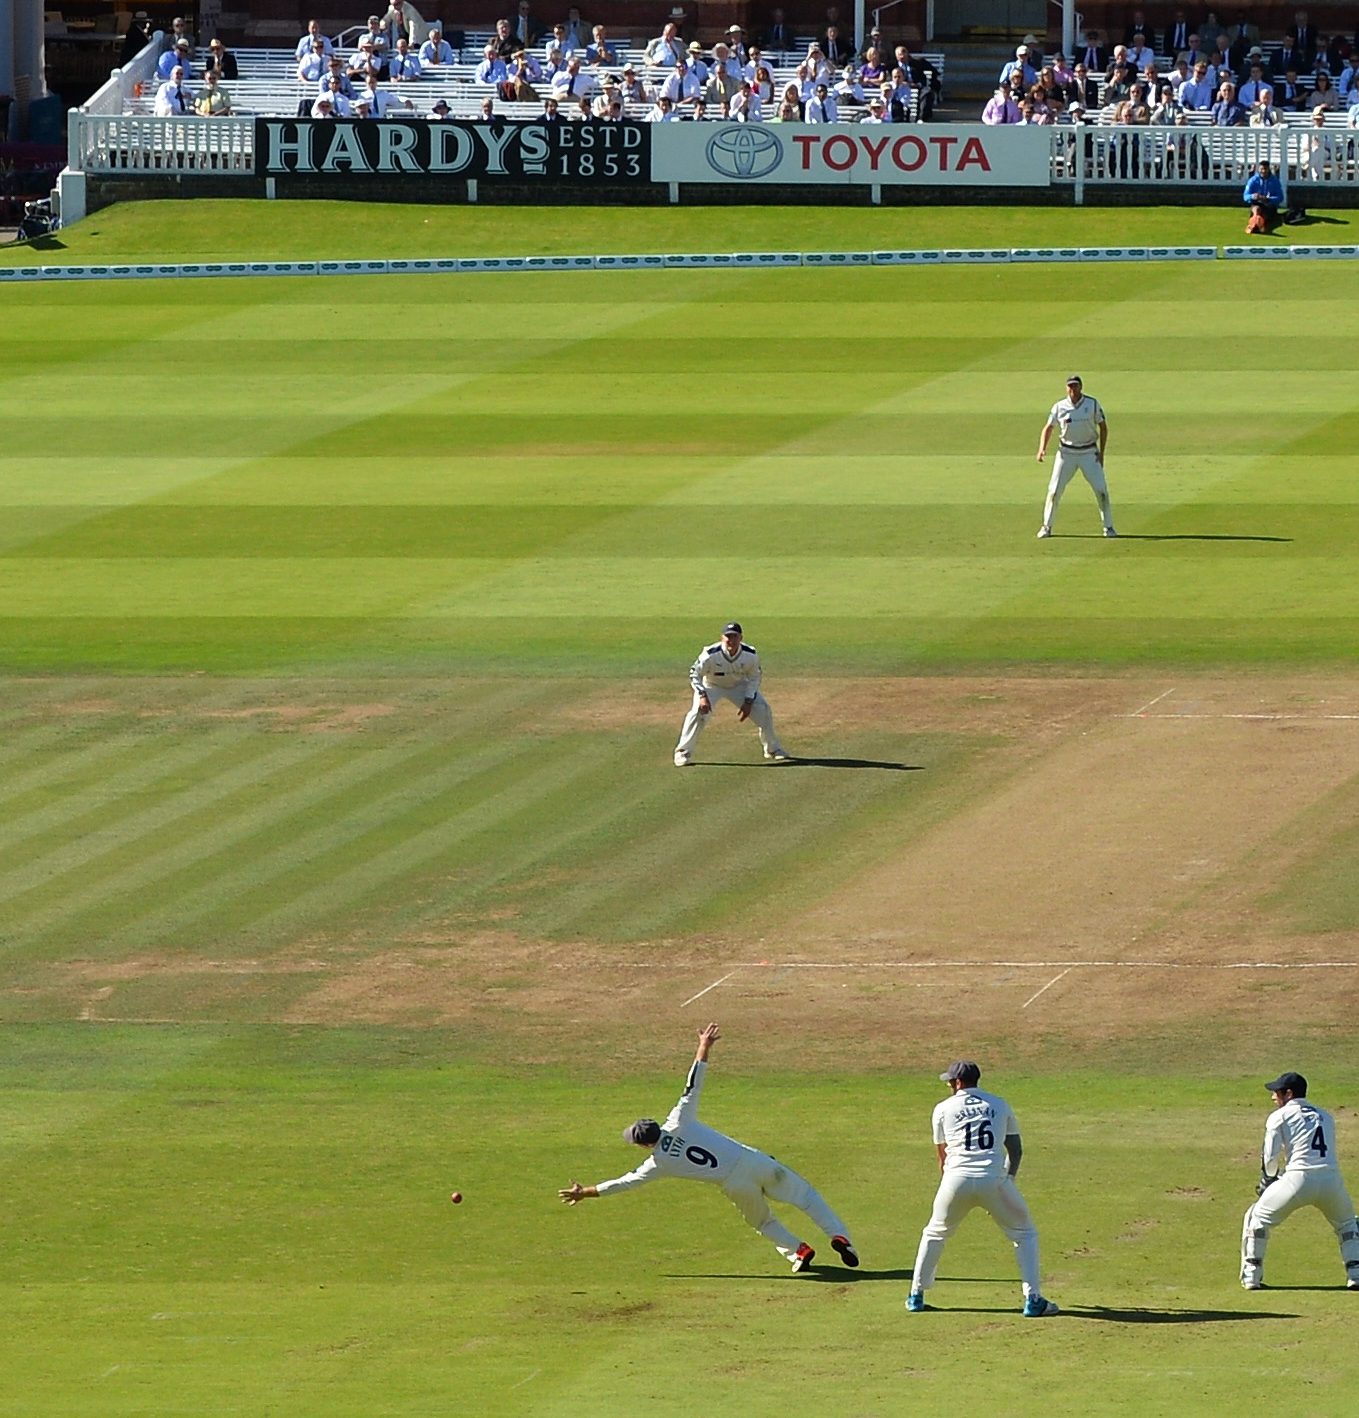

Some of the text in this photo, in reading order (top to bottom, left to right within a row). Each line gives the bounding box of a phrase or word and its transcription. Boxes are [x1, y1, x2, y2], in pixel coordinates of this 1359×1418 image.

[266, 123, 550, 175] HARDYS
[559, 126, 642, 148] ESTD
[560, 153, 641, 176] 1853
[792, 135, 992, 173] TOYOTA
[669, 1136, 686, 1158] LYTH
[965, 1120, 995, 1152] 16
[1311, 1125, 1327, 1158] 4
[685, 1145, 718, 1169] 9
